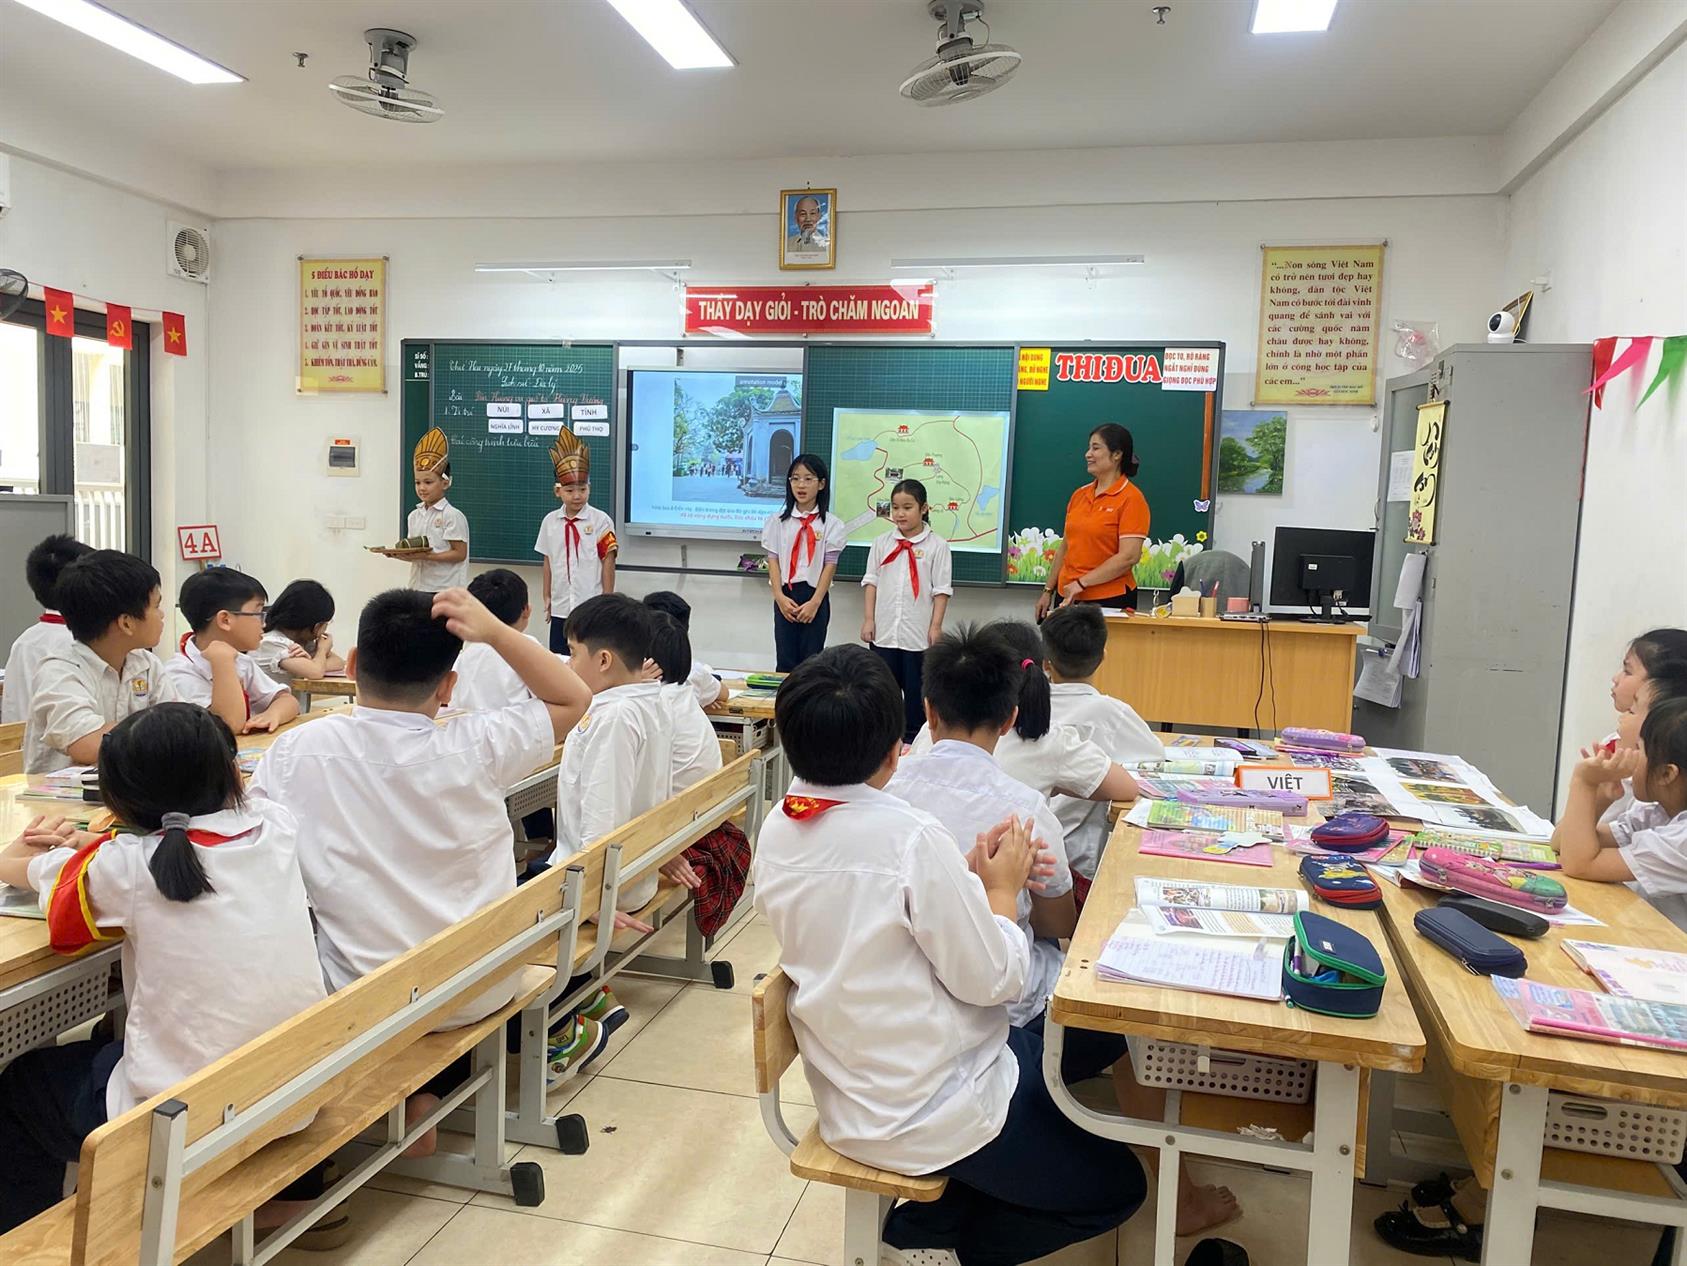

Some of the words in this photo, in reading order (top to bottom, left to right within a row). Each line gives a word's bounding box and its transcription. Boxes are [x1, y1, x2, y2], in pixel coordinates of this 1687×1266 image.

[1307, 261, 1326, 269] sông
[360, 270, 374, 280] DẠY
[1339, 273, 1353, 282] đẹp
[1357, 272, 1372, 280] hay
[1354, 286, 1372, 295] Việt
[736, 301, 761, 326] DẠY
[766, 293, 791, 320] GIỎI
[801, 296, 826, 320] TRÒ
[830, 296, 867, 320] CHĂM
[871, 299, 919, 320] NGOAN
[1300, 310, 1310, 319] để
[1293, 337, 1313, 346] được
[1319, 337, 1333, 346] hay
[1165, 353, 1176, 361] ĐỌC
[1187, 352, 1194, 360] RÕ
[1195, 351, 1209, 360] RÀNG
[1326, 350, 1342, 358] một
[1346, 350, 1368, 359] phần
[1282, 362, 1288, 370] ở
[1291, 362, 1311, 372] công
[1315, 363, 1330, 371] học
[1334, 363, 1348, 372] tập
[1352, 362, 1367, 371] của
[185, 533, 217, 553] 4A
[1267, 773, 1303, 793] VIỆT
